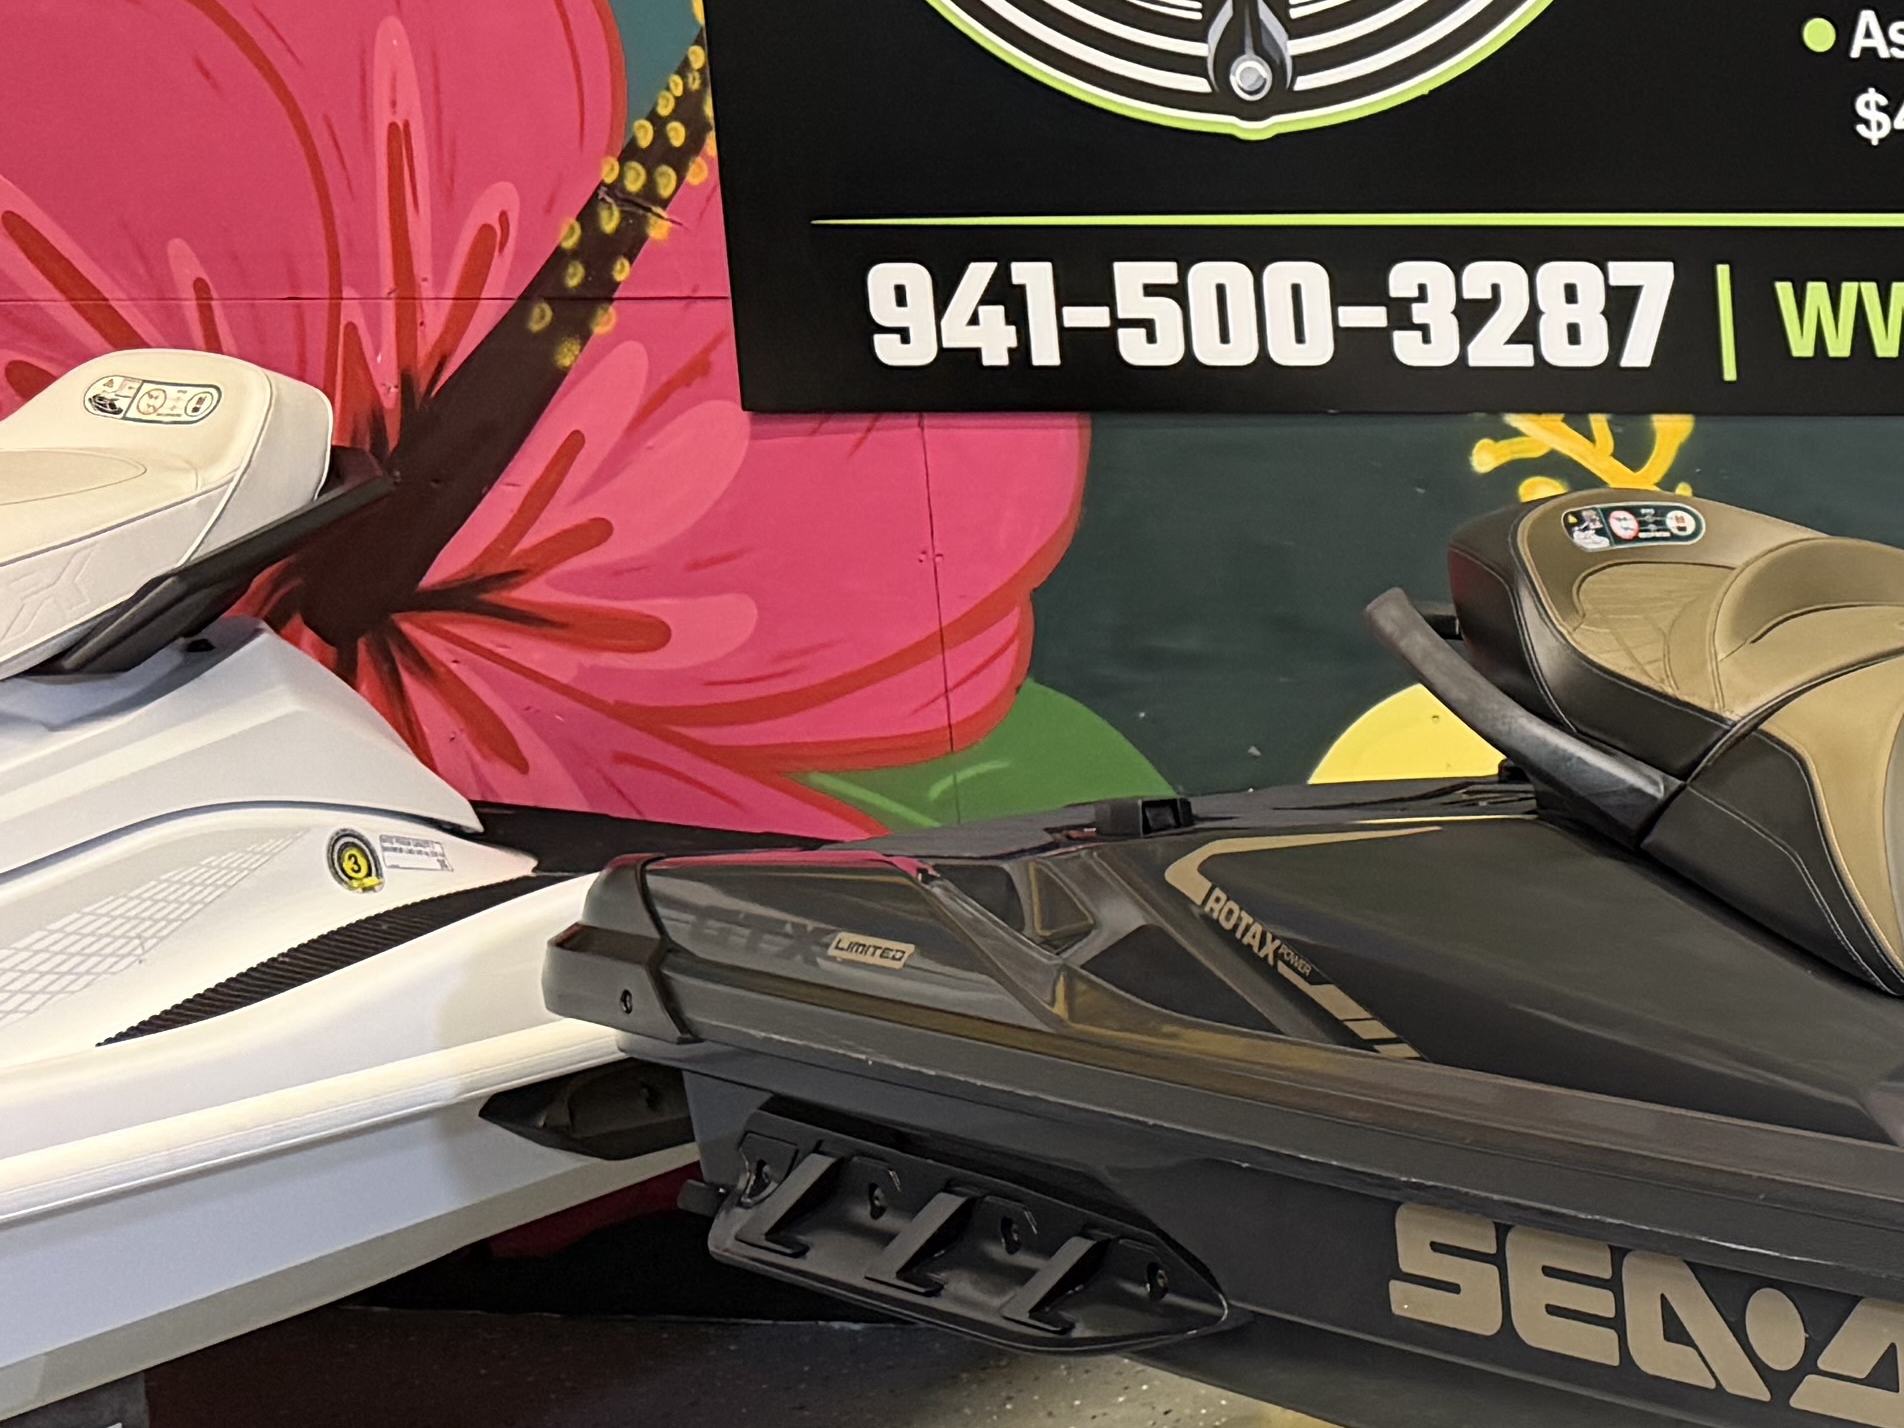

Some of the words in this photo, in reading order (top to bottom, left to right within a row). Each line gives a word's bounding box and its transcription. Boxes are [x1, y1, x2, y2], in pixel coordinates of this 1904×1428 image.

[867, 261, 1674, 367] 941-500-3287
[834, 938, 906, 961] LIMITED
[1204, 887, 1281, 967] ROTAX
[1279, 944, 1312, 977] POWER
